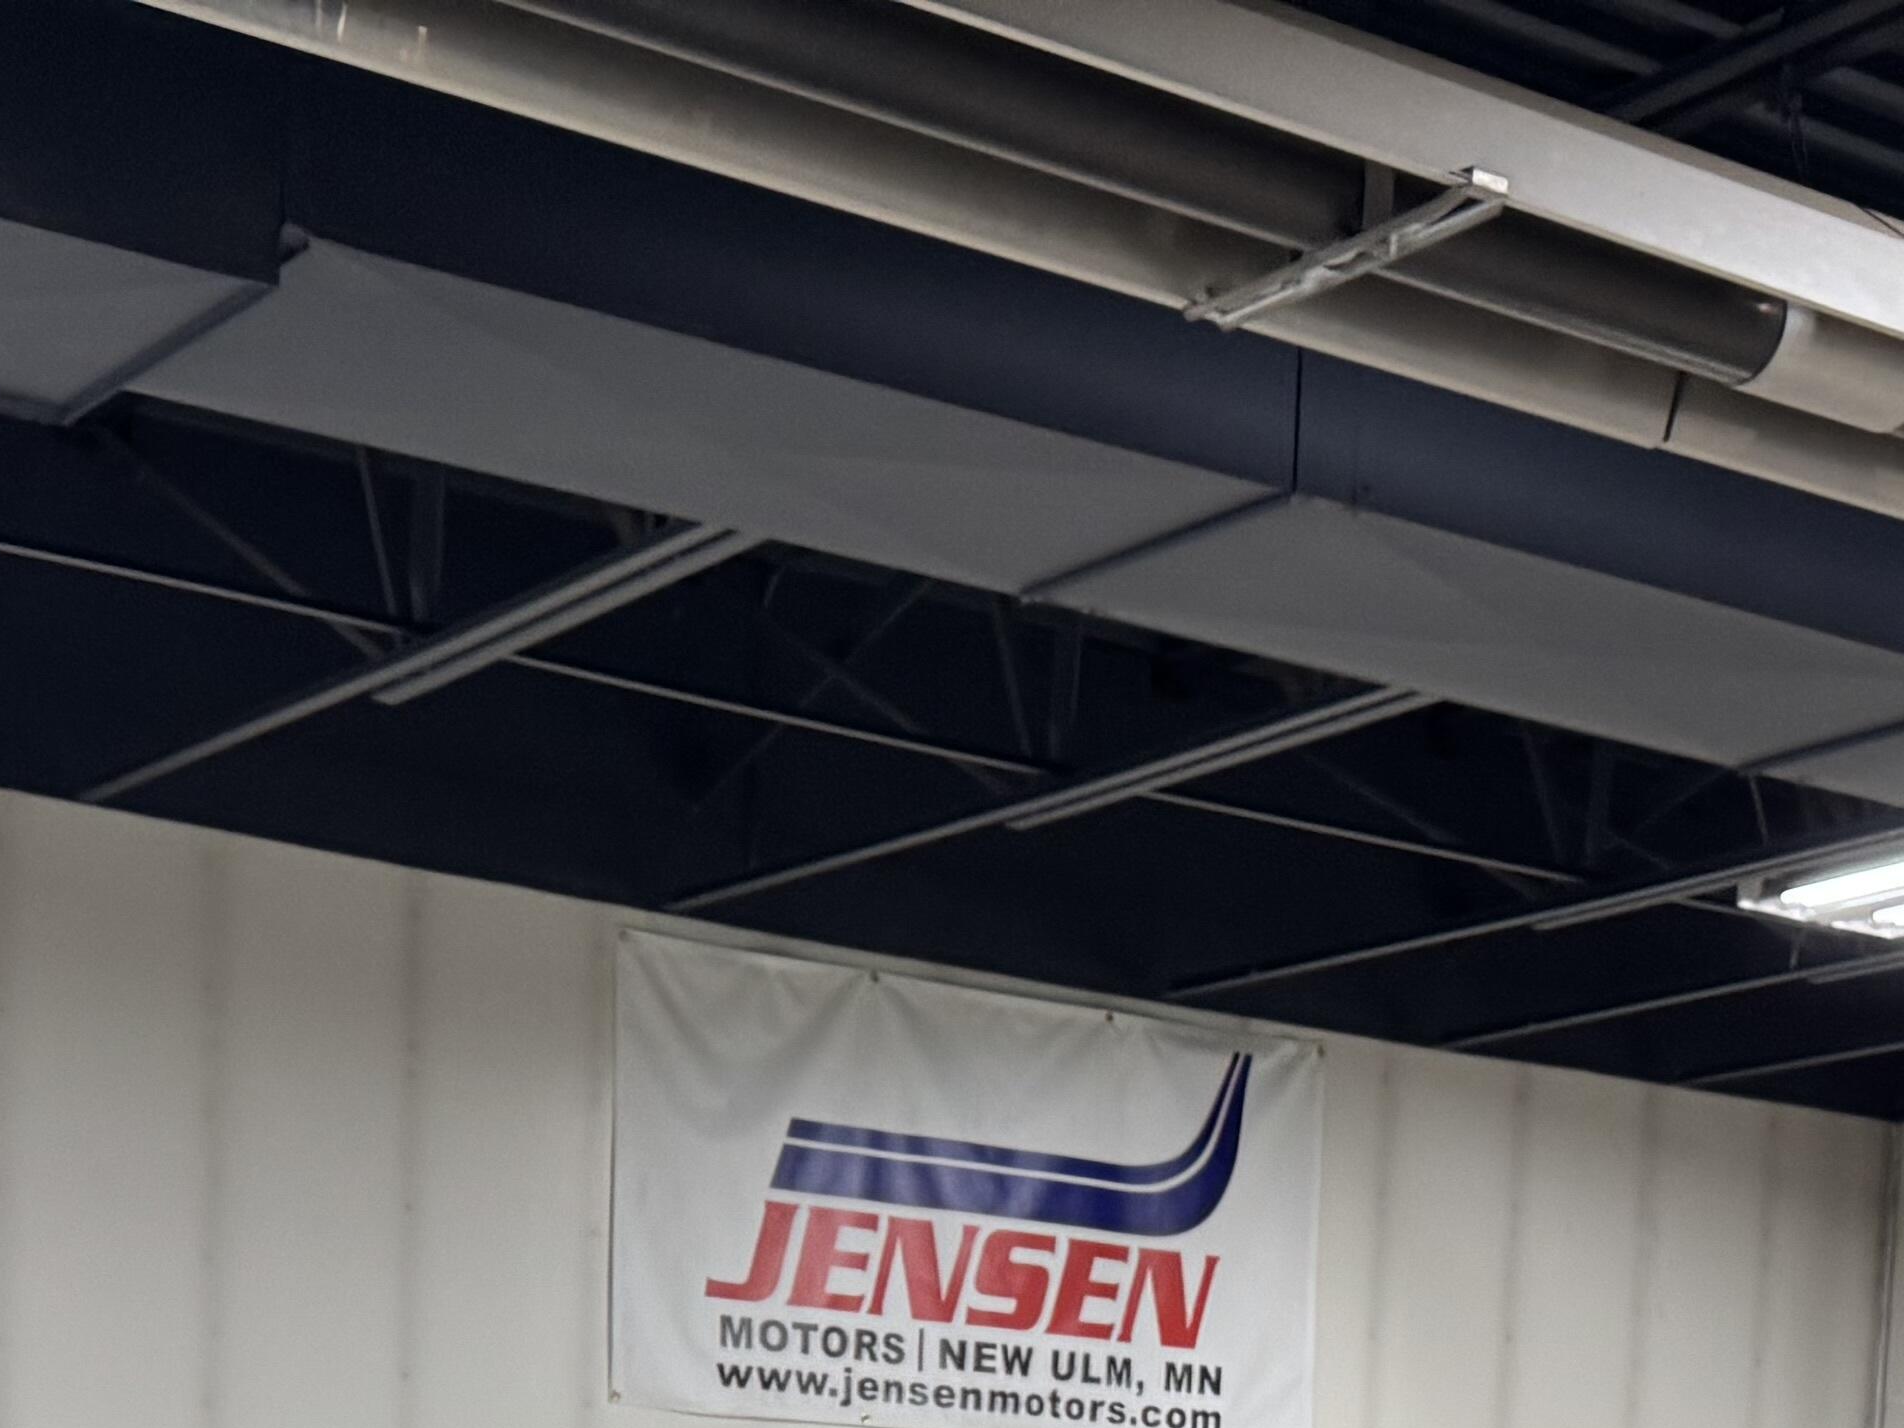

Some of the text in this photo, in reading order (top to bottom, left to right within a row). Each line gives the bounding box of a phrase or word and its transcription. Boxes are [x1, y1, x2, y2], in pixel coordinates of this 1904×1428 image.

[704, 1199, 1221, 1350] JENSEN
[719, 1313, 1223, 1396] MOTORS NEW ULM, MN
